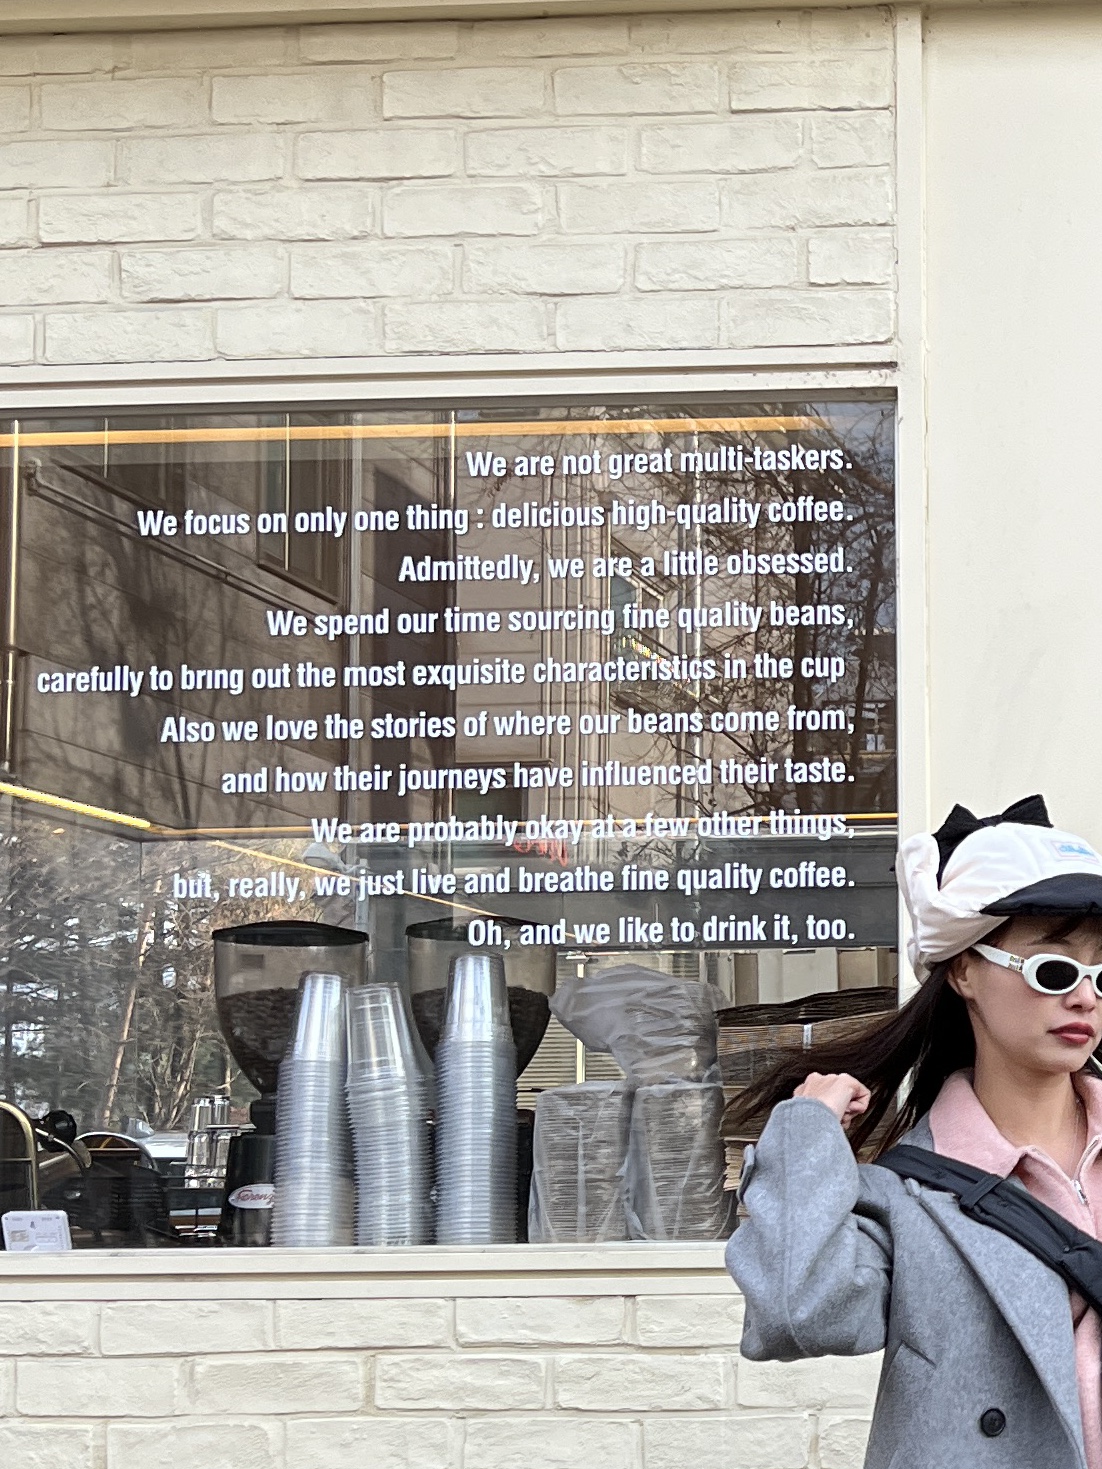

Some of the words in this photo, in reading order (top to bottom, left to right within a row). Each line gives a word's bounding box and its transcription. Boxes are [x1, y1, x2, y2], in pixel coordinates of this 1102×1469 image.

[465, 450, 507, 476] We
[514, 455, 555, 476] are
[561, 449, 602, 475] not
[608, 448, 673, 480] great
[678, 445, 853, 473] multi-taskers.
[137, 510, 178, 536] We
[185, 508, 251, 535] focus
[257, 513, 287, 534] on
[294, 506, 348, 538] only
[354, 511, 400, 532] one
[405, 504, 469, 536] thing
[491, 501, 605, 529] delicious
[612, 498, 762, 530] high-quality
[767, 496, 854, 524] coffee.
[398, 553, 540, 585] Admittedly,
[547, 558, 585, 578] we
[592, 557, 632, 577] are
[640, 556, 653, 576] a
[663, 549, 719, 576] little
[726, 546, 854, 575] obsessed.
[266, 609, 308, 635] We
[314, 607, 390, 639] spend
[397, 612, 440, 633] our
[445, 606, 501, 632] time
[507, 604, 615, 635] sourcing
[622, 603, 670, 629] fine
[677, 601, 763, 633] quality
[770, 599, 855, 629] beans,
[36, 665, 145, 696] carefully
[150, 664, 174, 690] to
[180, 663, 244, 694] bring
[251, 662, 292, 688] out
[297, 661, 336, 688] the
[343, 660, 406, 687] most
[411, 658, 526, 690] exquisite
[532, 655, 717, 683] characteristics
[724, 654, 747, 680] in
[754, 653, 793, 680] the
[800, 658, 846, 684] cup
[160, 716, 216, 742] Also
[221, 720, 258, 741] we
[266, 714, 318, 740] love
[325, 713, 364, 739] the
[370, 711, 457, 738] stories
[463, 711, 488, 737] of
[494, 709, 572, 736] where
[578, 714, 621, 735] our
[627, 707, 704, 734] beans
[710, 711, 780, 732] come
[786, 704, 855, 734] from,
[221, 766, 268, 792] and
[274, 765, 328, 791] how
[333, 764, 390, 790] their
[397, 762, 507, 793] journeys
[513, 760, 574, 787] have
[581, 758, 713, 786] influenced
[719, 757, 779, 783] their
[784, 755, 855, 782] taste.
[310, 816, 352, 842] We
[359, 821, 401, 841] are
[407, 813, 516, 845] probably
[524, 812, 583, 844] okay
[590, 811, 615, 837] at
[622, 817, 637, 837] a
[644, 810, 690, 836] few
[697, 809, 763, 836] other
[769, 807, 856, 839] things,
[173, 870, 221, 899] but,
[228, 869, 307, 900] really,
[314, 873, 352, 894] we
[358, 867, 405, 899] just
[411, 866, 457, 892] live
[464, 866, 511, 892] and
[518, 864, 615, 891] breathe
[621, 863, 670, 889] fine
[676, 862, 763, 893] quality
[768, 860, 856, 887] coffee.
[467, 919, 512, 948] Oh,
[519, 918, 566, 944] and
[573, 922, 611, 943] we
[618, 916, 663, 942] like
[670, 915, 695, 941] to
[702, 914, 766, 941] drink
[773, 913, 799, 943] it,
[805, 912, 856, 939] too.
